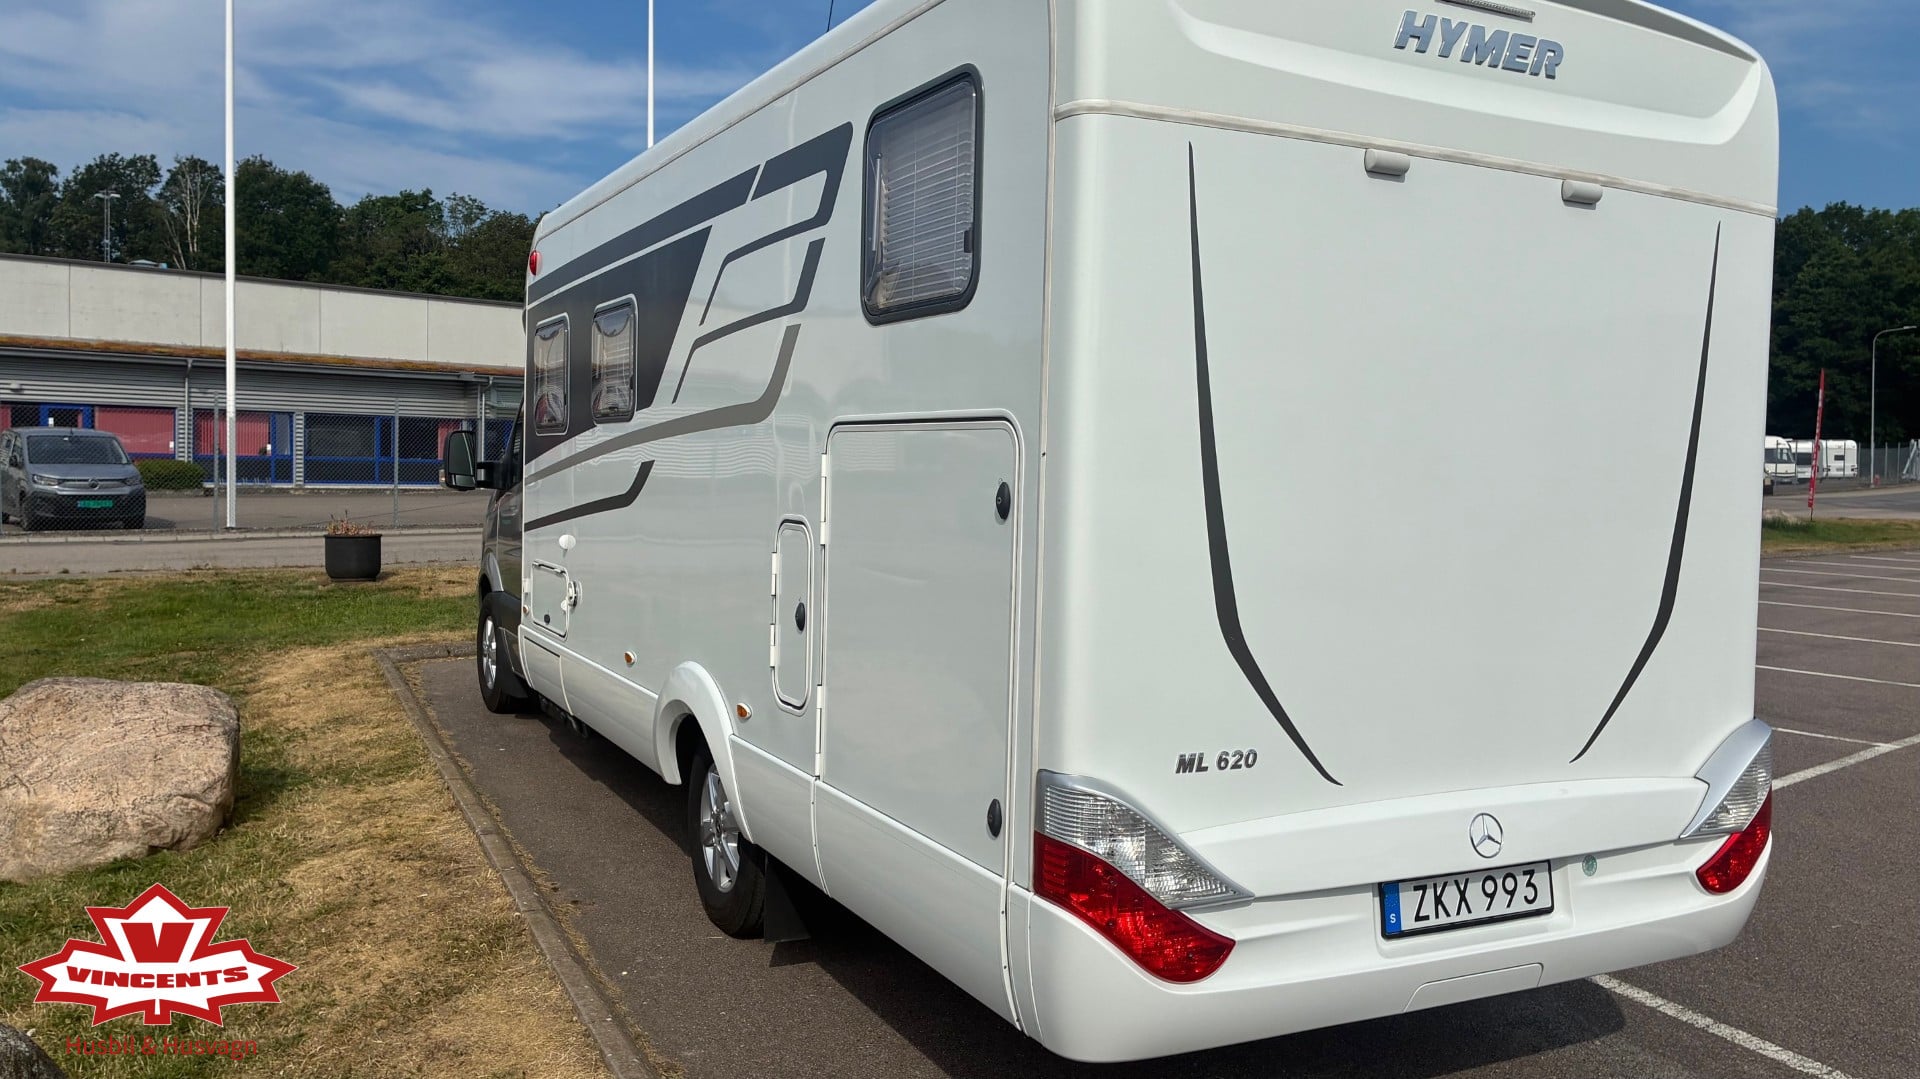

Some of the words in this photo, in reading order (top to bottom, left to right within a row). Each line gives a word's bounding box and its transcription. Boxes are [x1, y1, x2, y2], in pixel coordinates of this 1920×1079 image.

[1394, 10, 1564, 80] HYMER
[1175, 752, 1209, 774] ML
[1217, 748, 1258, 771] 620
[1413, 877, 1473, 923] ZKX
[1481, 869, 1538, 912] 993
[1389, 913, 1397, 924] S
